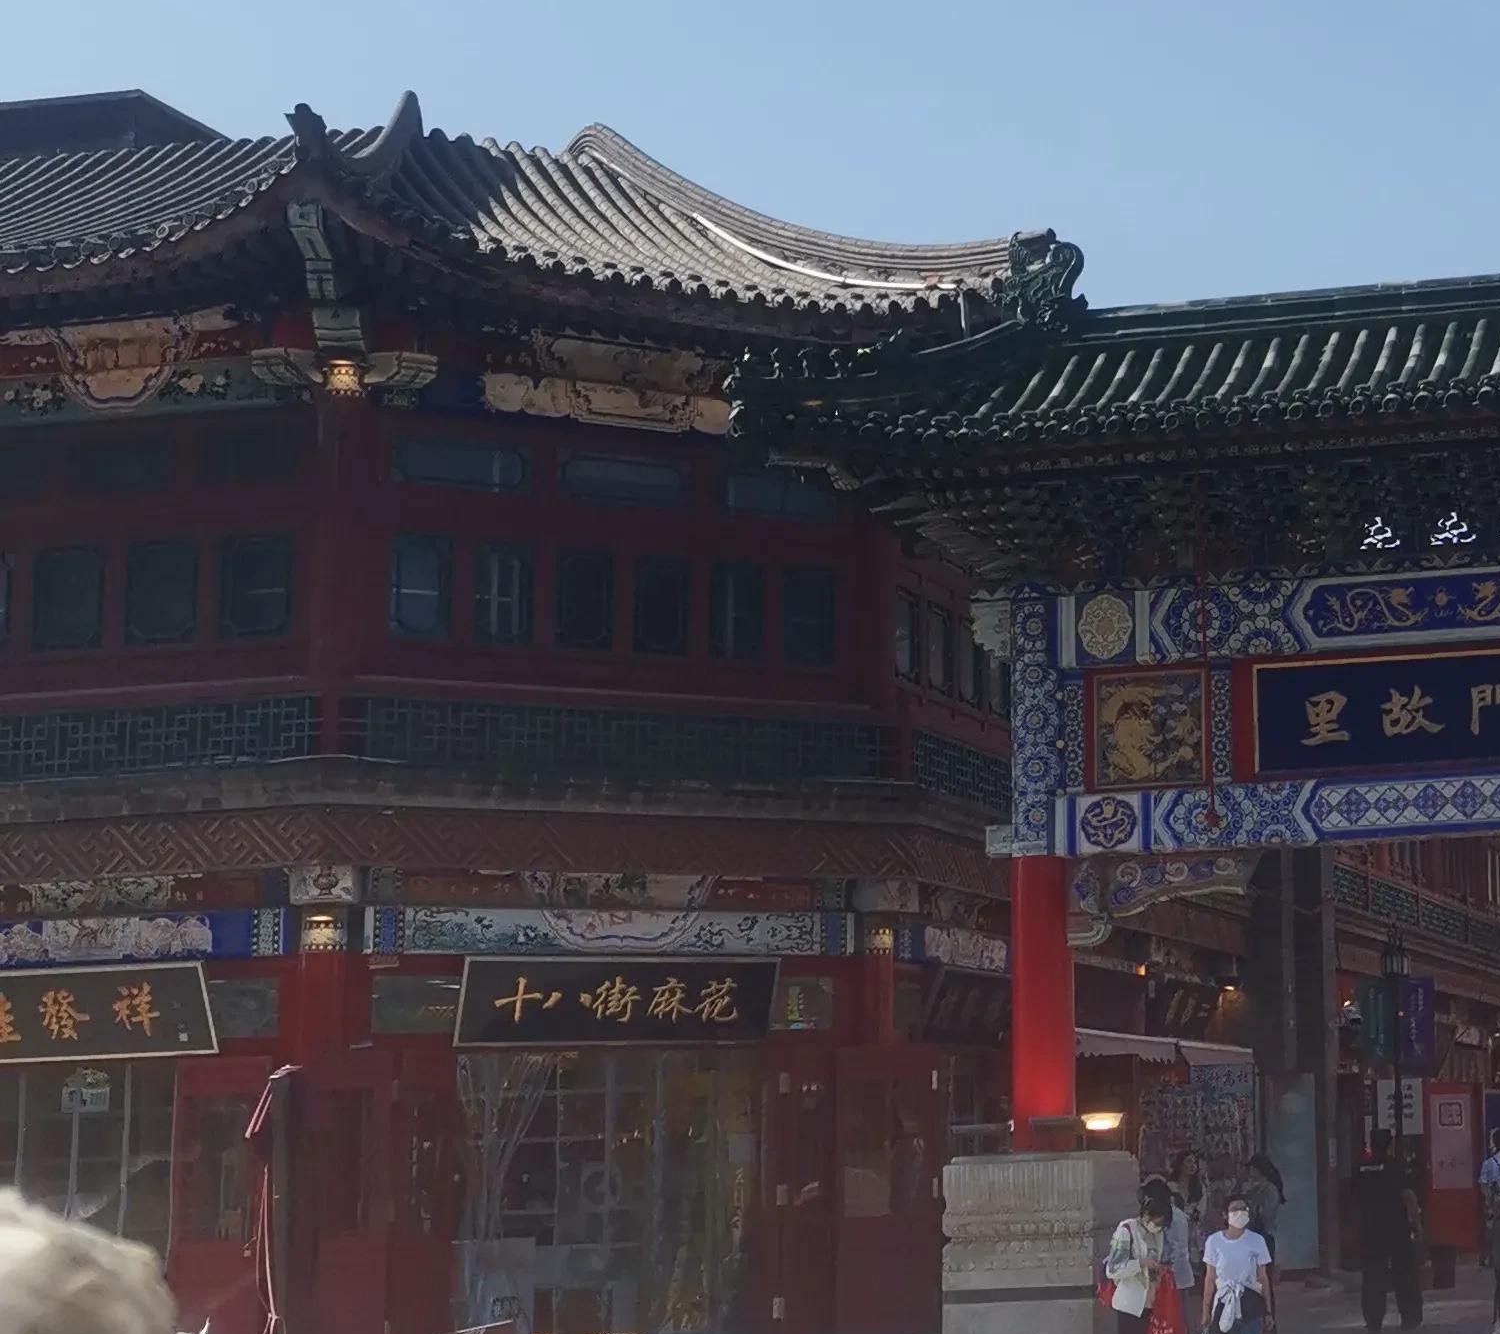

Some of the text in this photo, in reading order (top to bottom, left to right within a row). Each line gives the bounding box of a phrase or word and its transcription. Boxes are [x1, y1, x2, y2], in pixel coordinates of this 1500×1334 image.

[494, 976, 739, 1025] 十八街麻花
